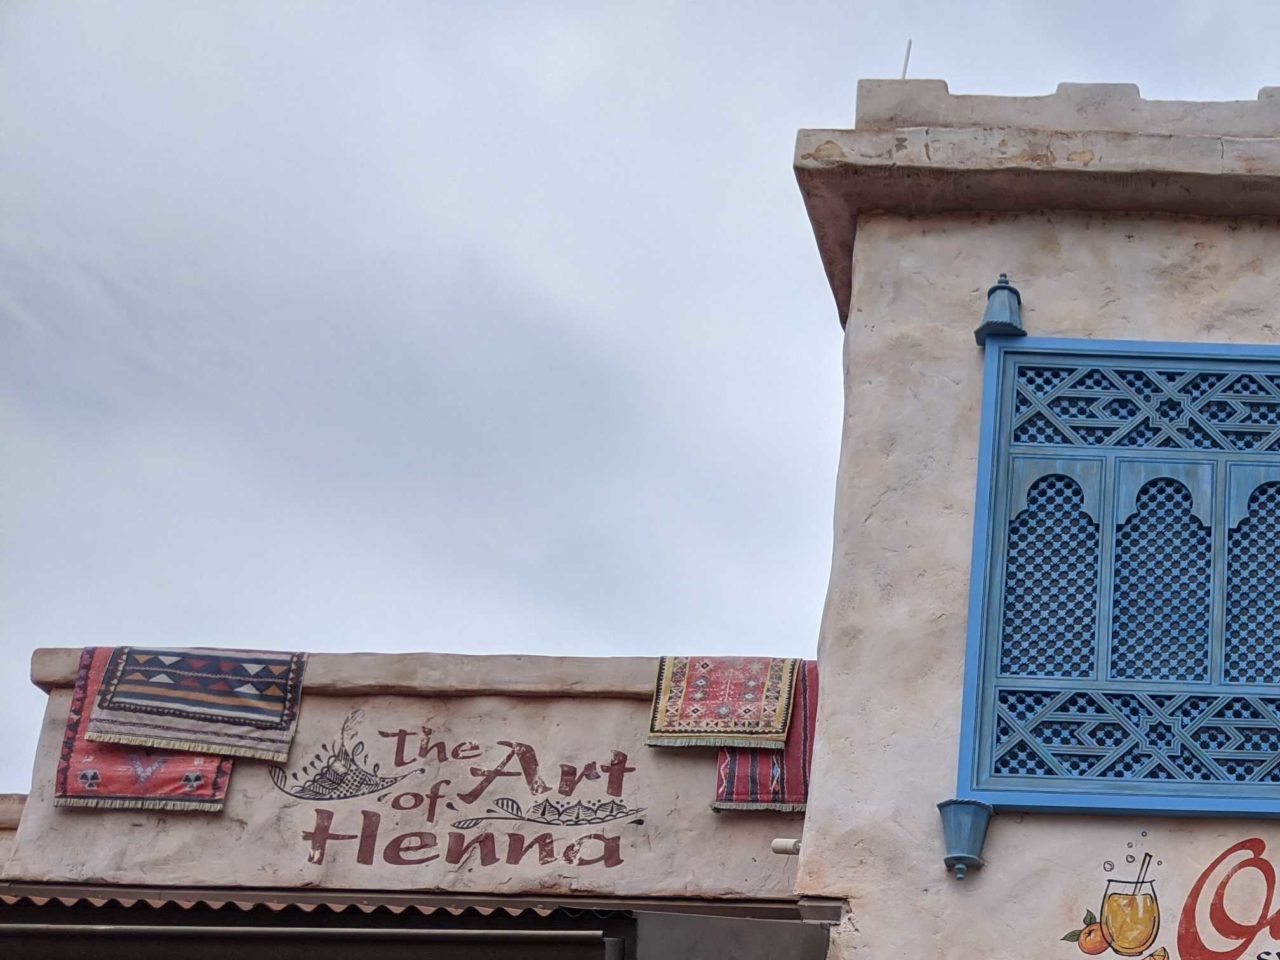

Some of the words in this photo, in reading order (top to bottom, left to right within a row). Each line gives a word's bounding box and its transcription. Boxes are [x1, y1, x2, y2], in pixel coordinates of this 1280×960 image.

[391, 779, 451, 823] of
[457, 740, 637, 805] Art
[302, 807, 626, 869] Henna
